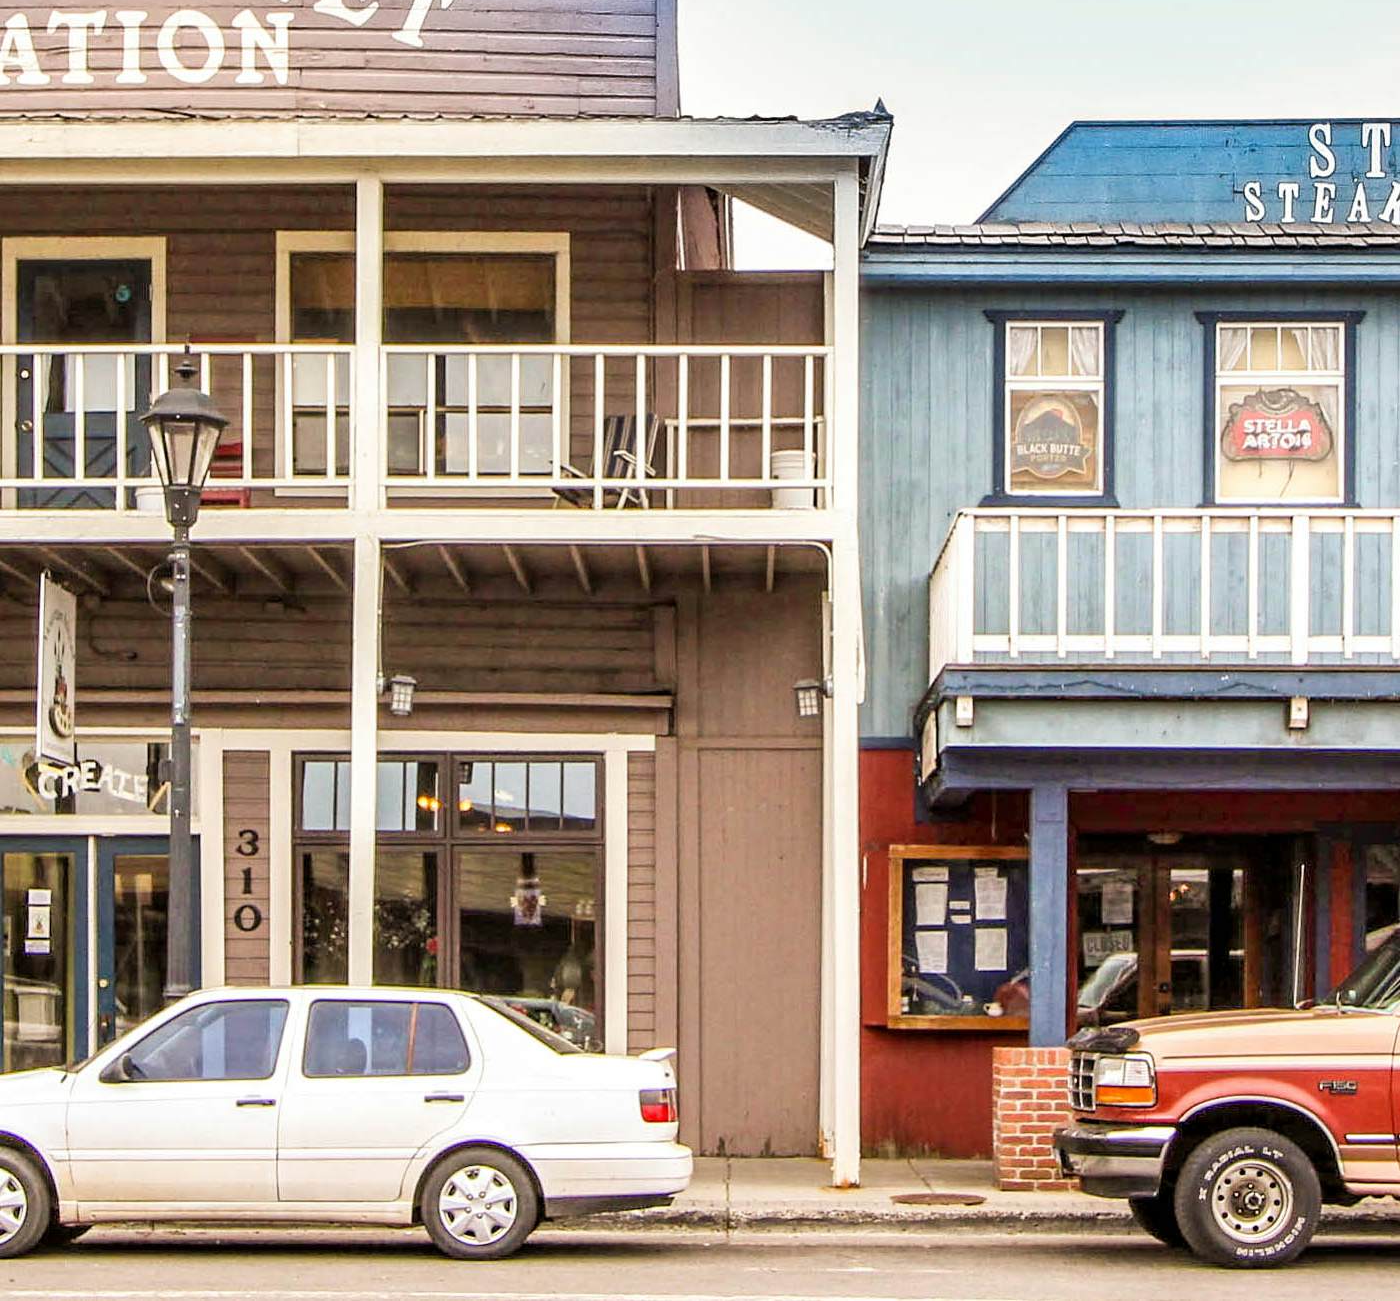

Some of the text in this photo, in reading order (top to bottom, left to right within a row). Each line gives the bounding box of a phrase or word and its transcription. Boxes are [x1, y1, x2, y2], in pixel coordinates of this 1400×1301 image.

[0, 9, 295, 85] ATION
[1308, 122, 1391, 179] ST
[1242, 432, 1312, 450] ARTOIS
[1243, 419, 1312, 433] STELLA
[1016, 443, 1081, 456] BLACK BUTTE
[37, 762, 149, 804] CREATE
[1204, 1145, 1254, 1180] RADIAL
[1262, 1147, 1284, 1159] LT
[1236, 1217, 1305, 1256] MICHELIN
